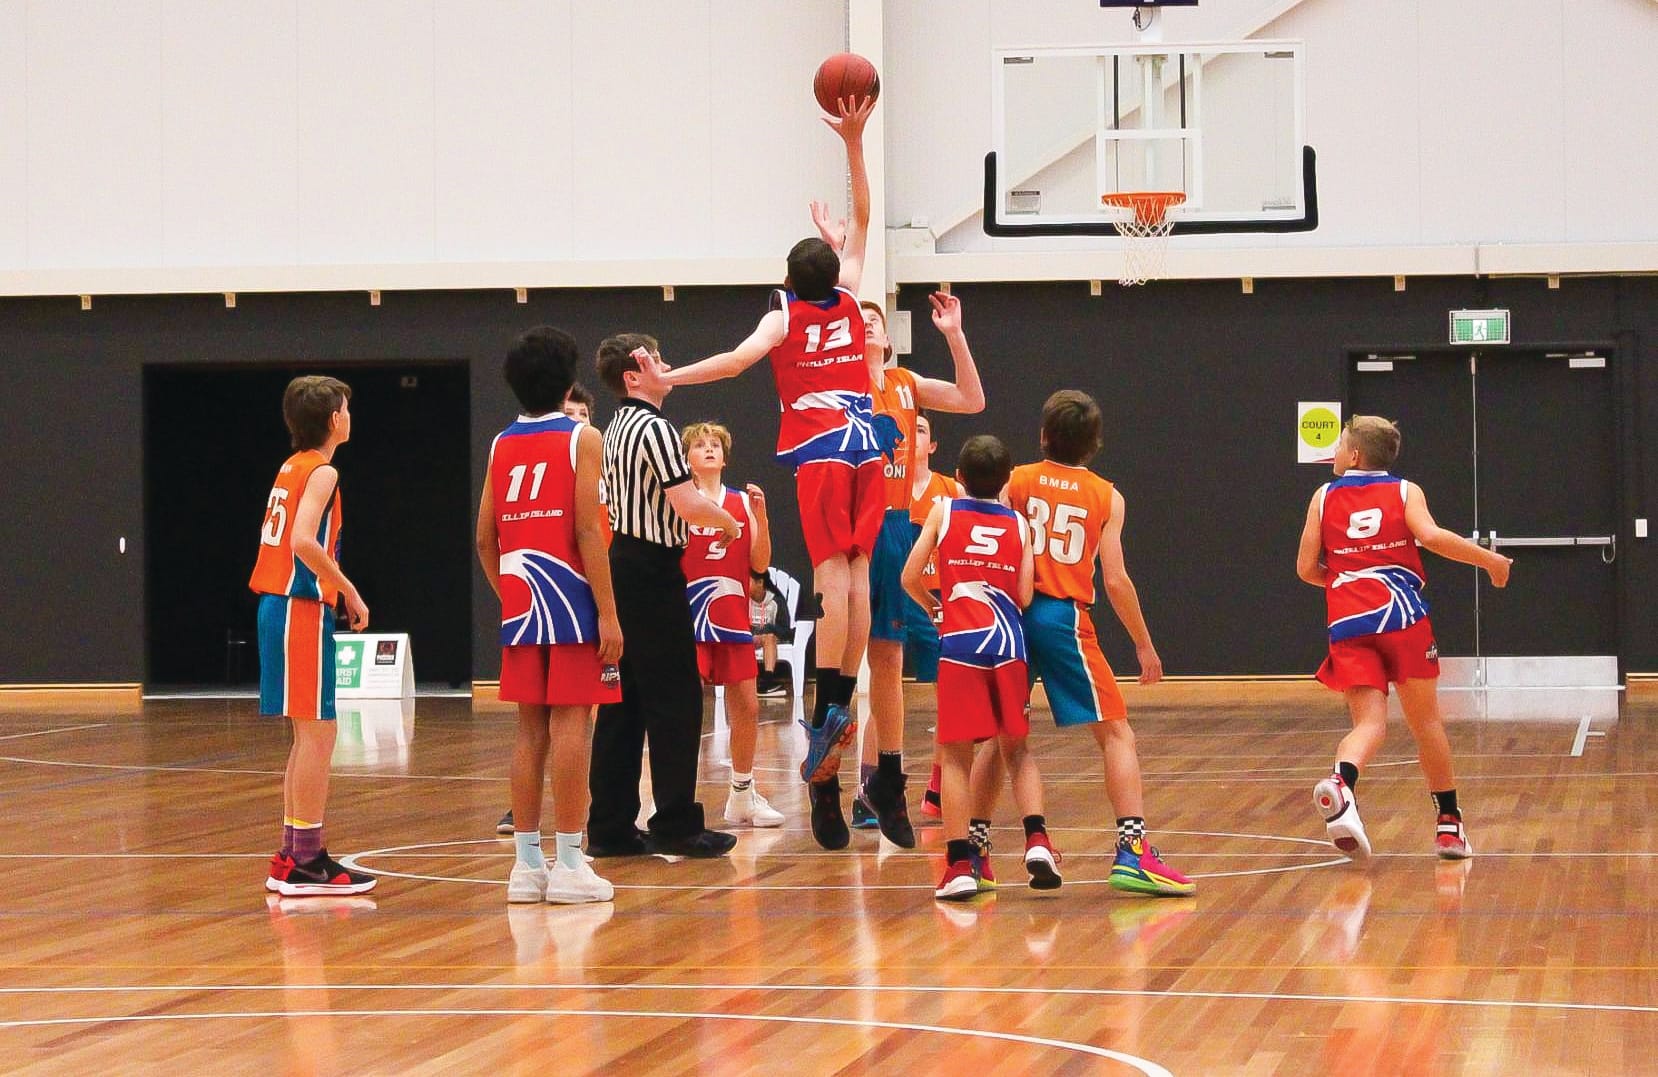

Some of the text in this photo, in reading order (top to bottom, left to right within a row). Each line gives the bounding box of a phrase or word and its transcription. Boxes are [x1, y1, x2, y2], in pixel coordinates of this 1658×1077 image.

[804, 316, 853, 353] 13
[896, 385, 915, 410] 11
[1302, 421, 1336, 429] COURT
[505, 462, 547, 502] 11
[1039, 475, 1079, 491] BMBA
[530, 509, 563, 518] ISLAND
[1346, 508, 1383, 539] 8
[964, 525, 1007, 556] 5
[1026, 496, 1088, 564] 35
